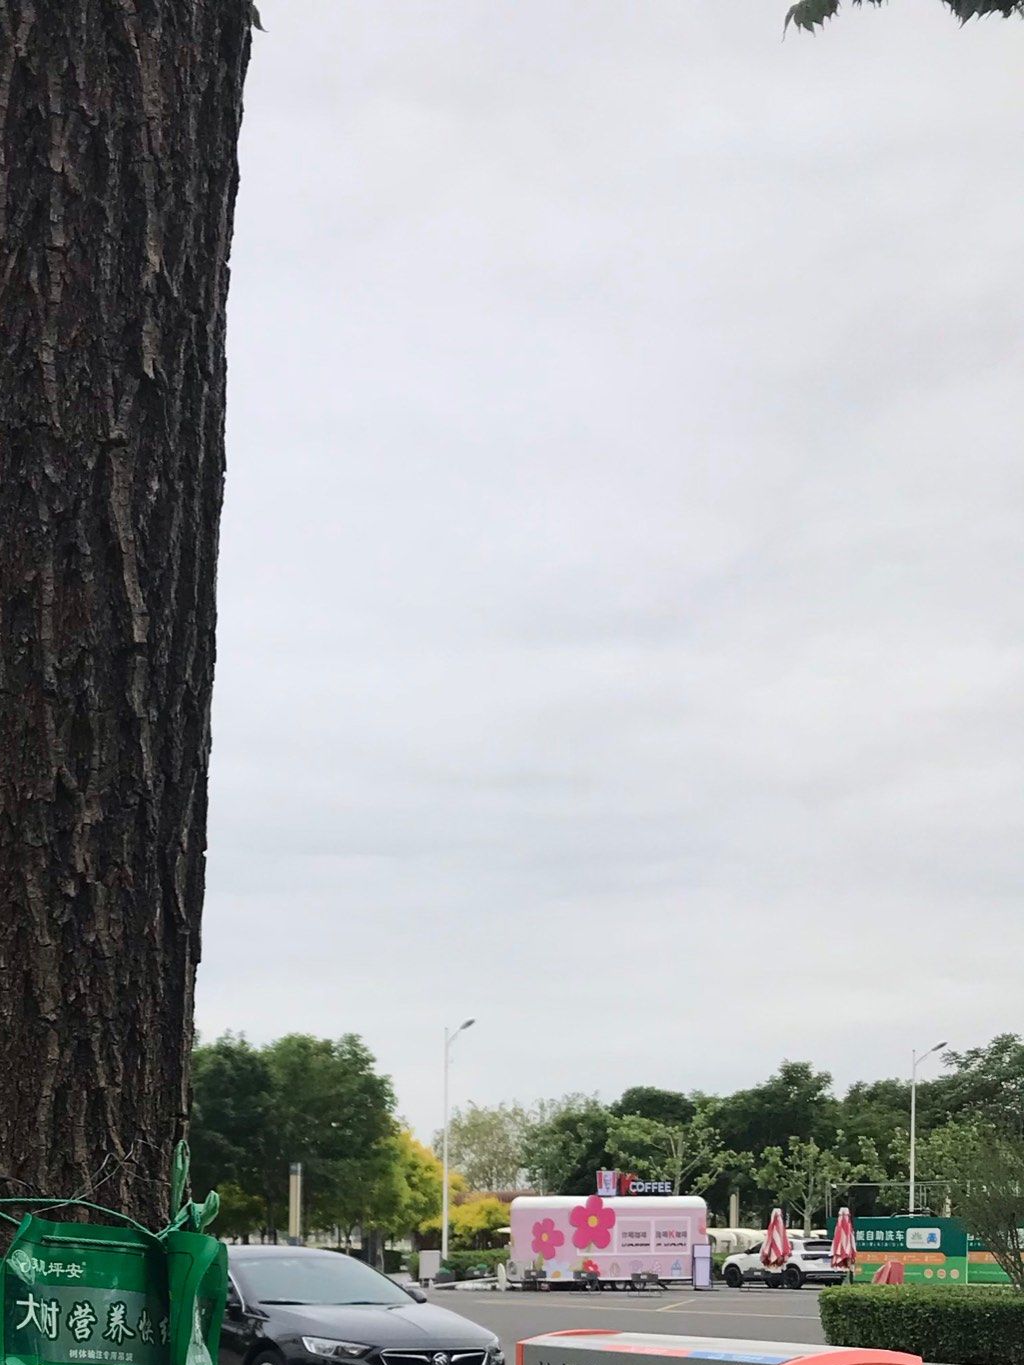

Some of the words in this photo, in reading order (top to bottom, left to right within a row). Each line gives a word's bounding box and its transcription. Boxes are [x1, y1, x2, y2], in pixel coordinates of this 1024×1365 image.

[629, 1181, 672, 1193] COFFEE
[854, 1230, 904, 1242] 能自助洗车
